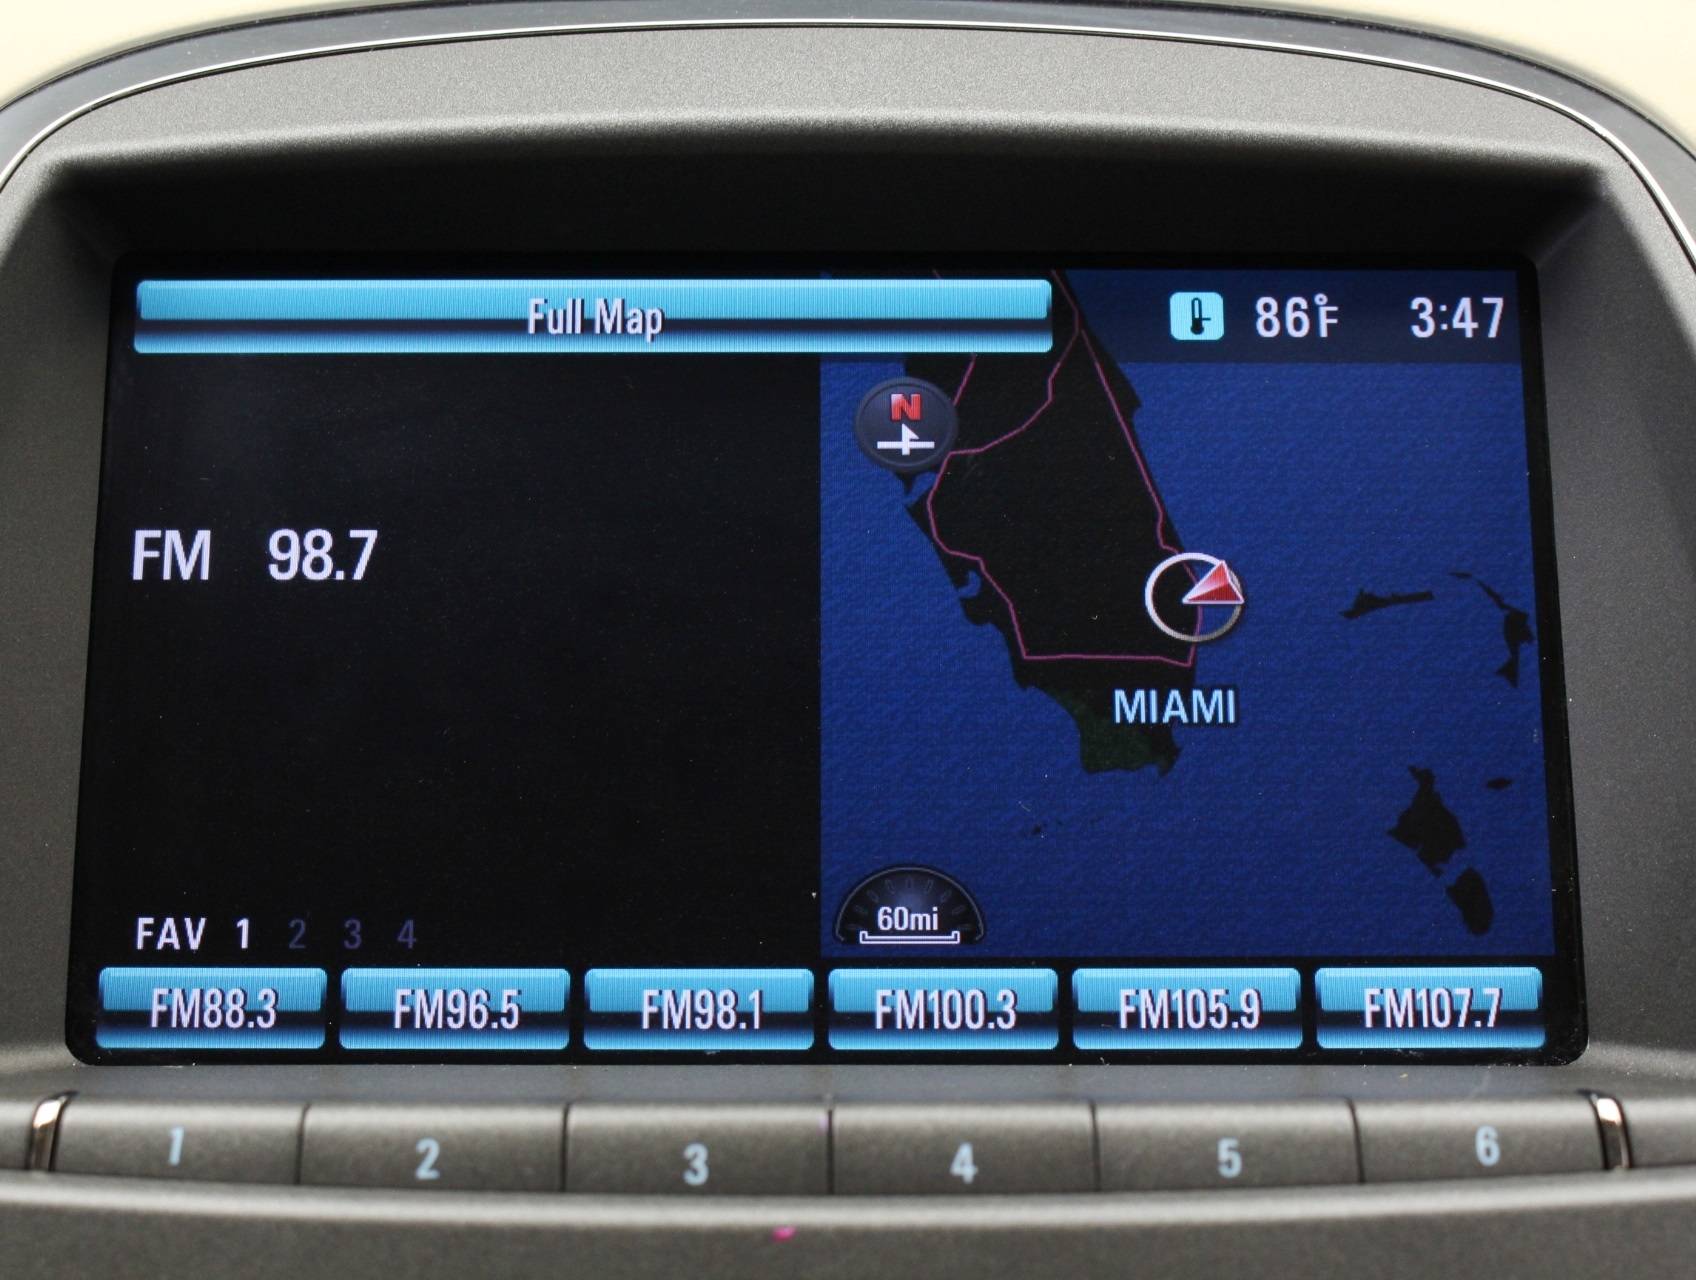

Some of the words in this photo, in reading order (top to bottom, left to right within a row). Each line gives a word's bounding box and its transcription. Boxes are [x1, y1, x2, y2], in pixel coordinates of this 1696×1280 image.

[528, 297, 582, 335] Full
[595, 297, 662, 343] Map
[1412, 297, 1503, 338] 3:47
[891, 393, 922, 421] N
[133, 530, 211, 580] FM
[269, 528, 378, 580] 98.7
[1115, 690, 1234, 723] MIAMI
[137, 917, 206, 950] FAV
[237, 918, 249, 949] 1
[288, 919, 306, 949] 2
[344, 918, 362, 949] 3
[397, 919, 417, 949] 4
[878, 905, 940, 931] 60mi
[151, 988, 276, 1028] FM88.3
[395, 988, 519, 1029] FM96.5
[642, 989, 760, 1030] FM98.1
[876, 988, 1016, 1030] FM100.3
[1120, 988, 1260, 1029] FM105.9
[1364, 987, 1500, 1028] FM107.7
[168, 1124, 186, 1166] 1
[415, 1136, 441, 1181] 2
[681, 1141, 711, 1185] 3
[949, 1141, 977, 1183] 4
[1216, 1136, 1242, 1179] 5
[1475, 1124, 1501, 1167] 6
